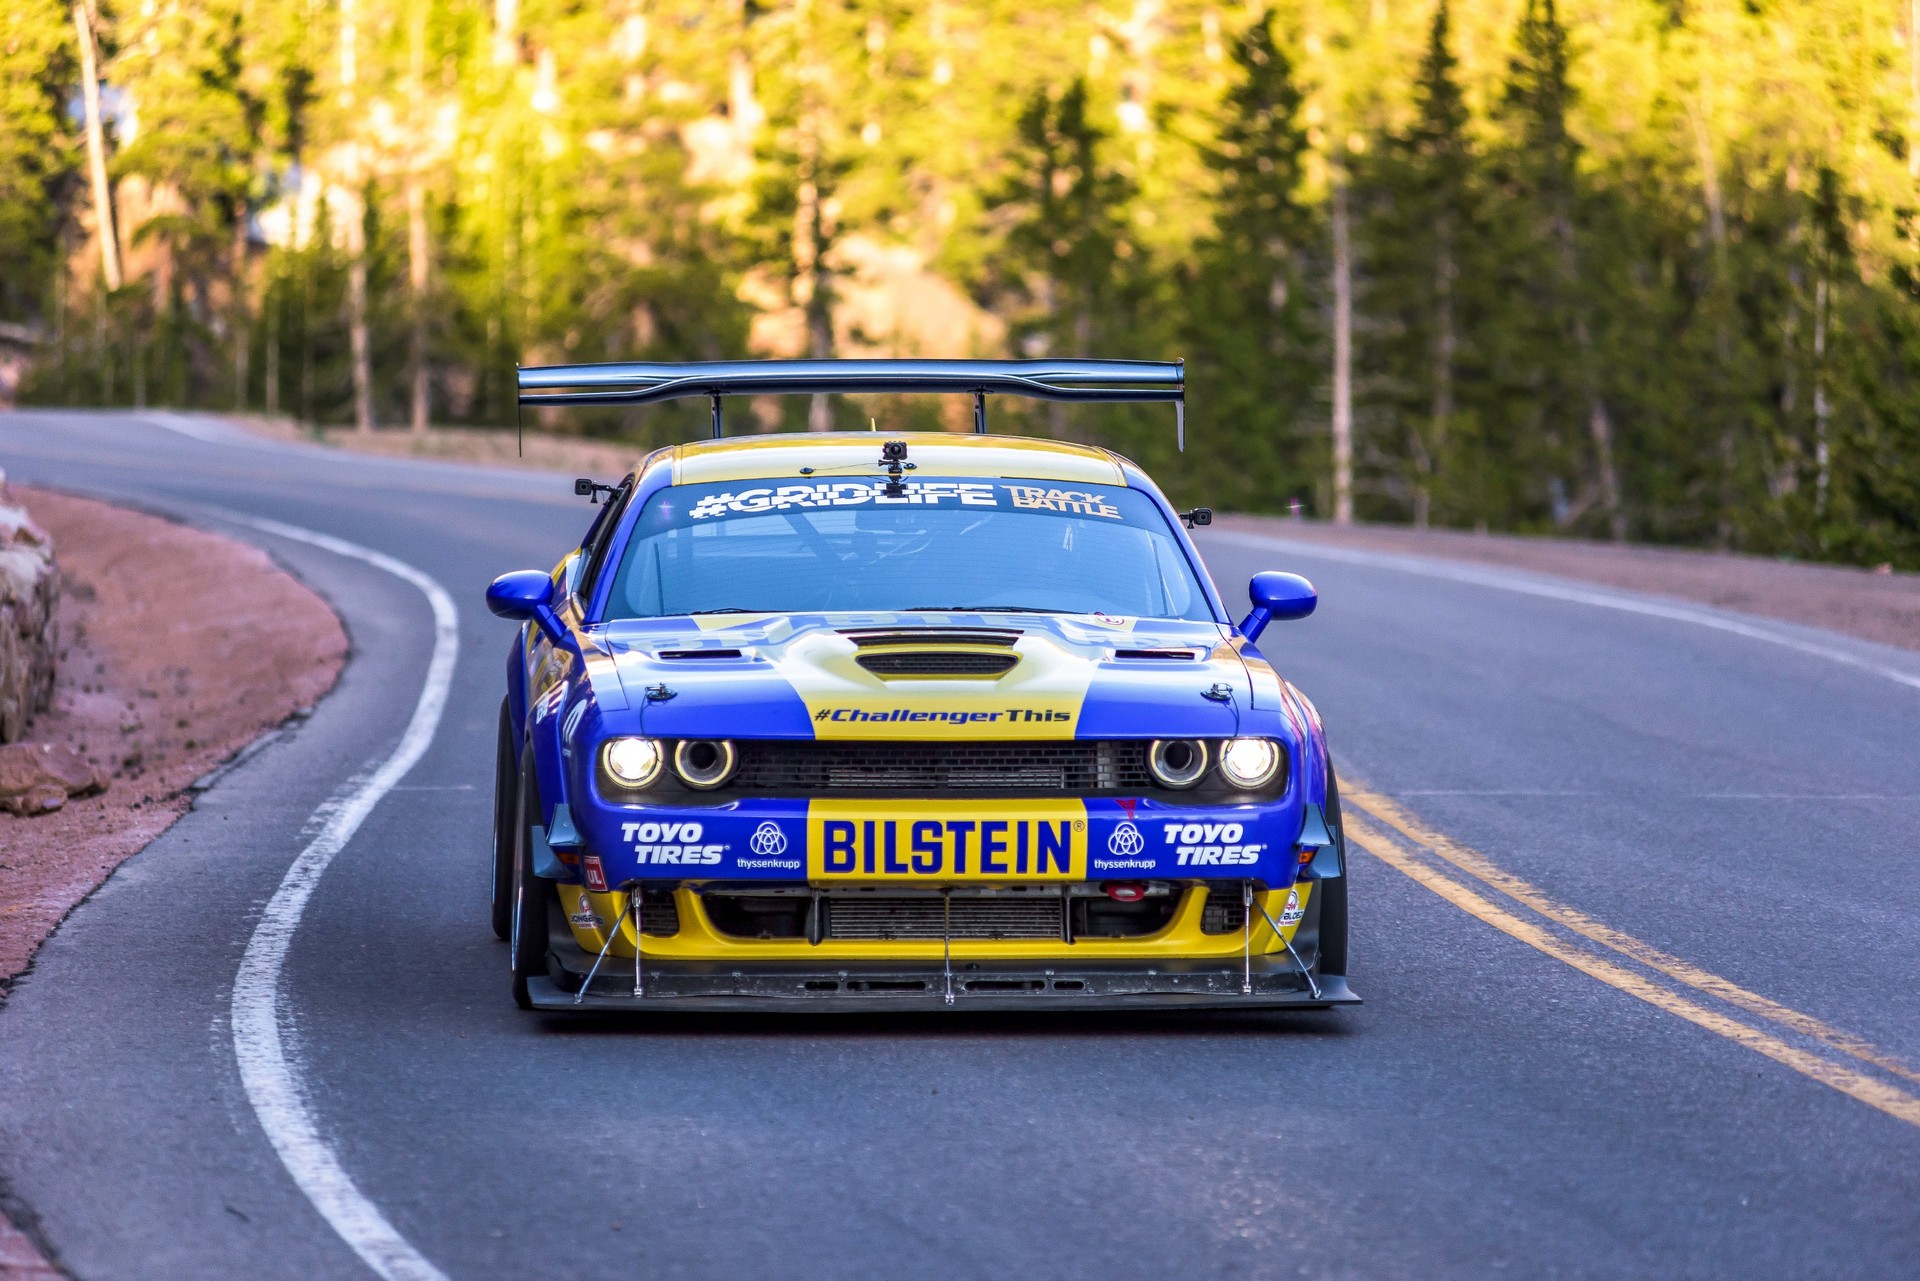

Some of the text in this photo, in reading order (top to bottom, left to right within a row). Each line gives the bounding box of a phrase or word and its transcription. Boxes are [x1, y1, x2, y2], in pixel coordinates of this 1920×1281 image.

[689, 482, 998, 519] #GRIDLIFE
[999, 484, 1106, 504] TRACK
[1013, 497, 1123, 519] BATTLE
[814, 709, 1071, 725] #ChallengerThis
[621, 823, 702, 843] TOYO
[1164, 823, 1244, 844] TOYO
[635, 845, 723, 865] TIRES
[737, 858, 800, 870] thyssenkrupp
[1094, 859, 1156, 870] thyssenkrupp
[1176, 845, 1262, 866] TIRES
